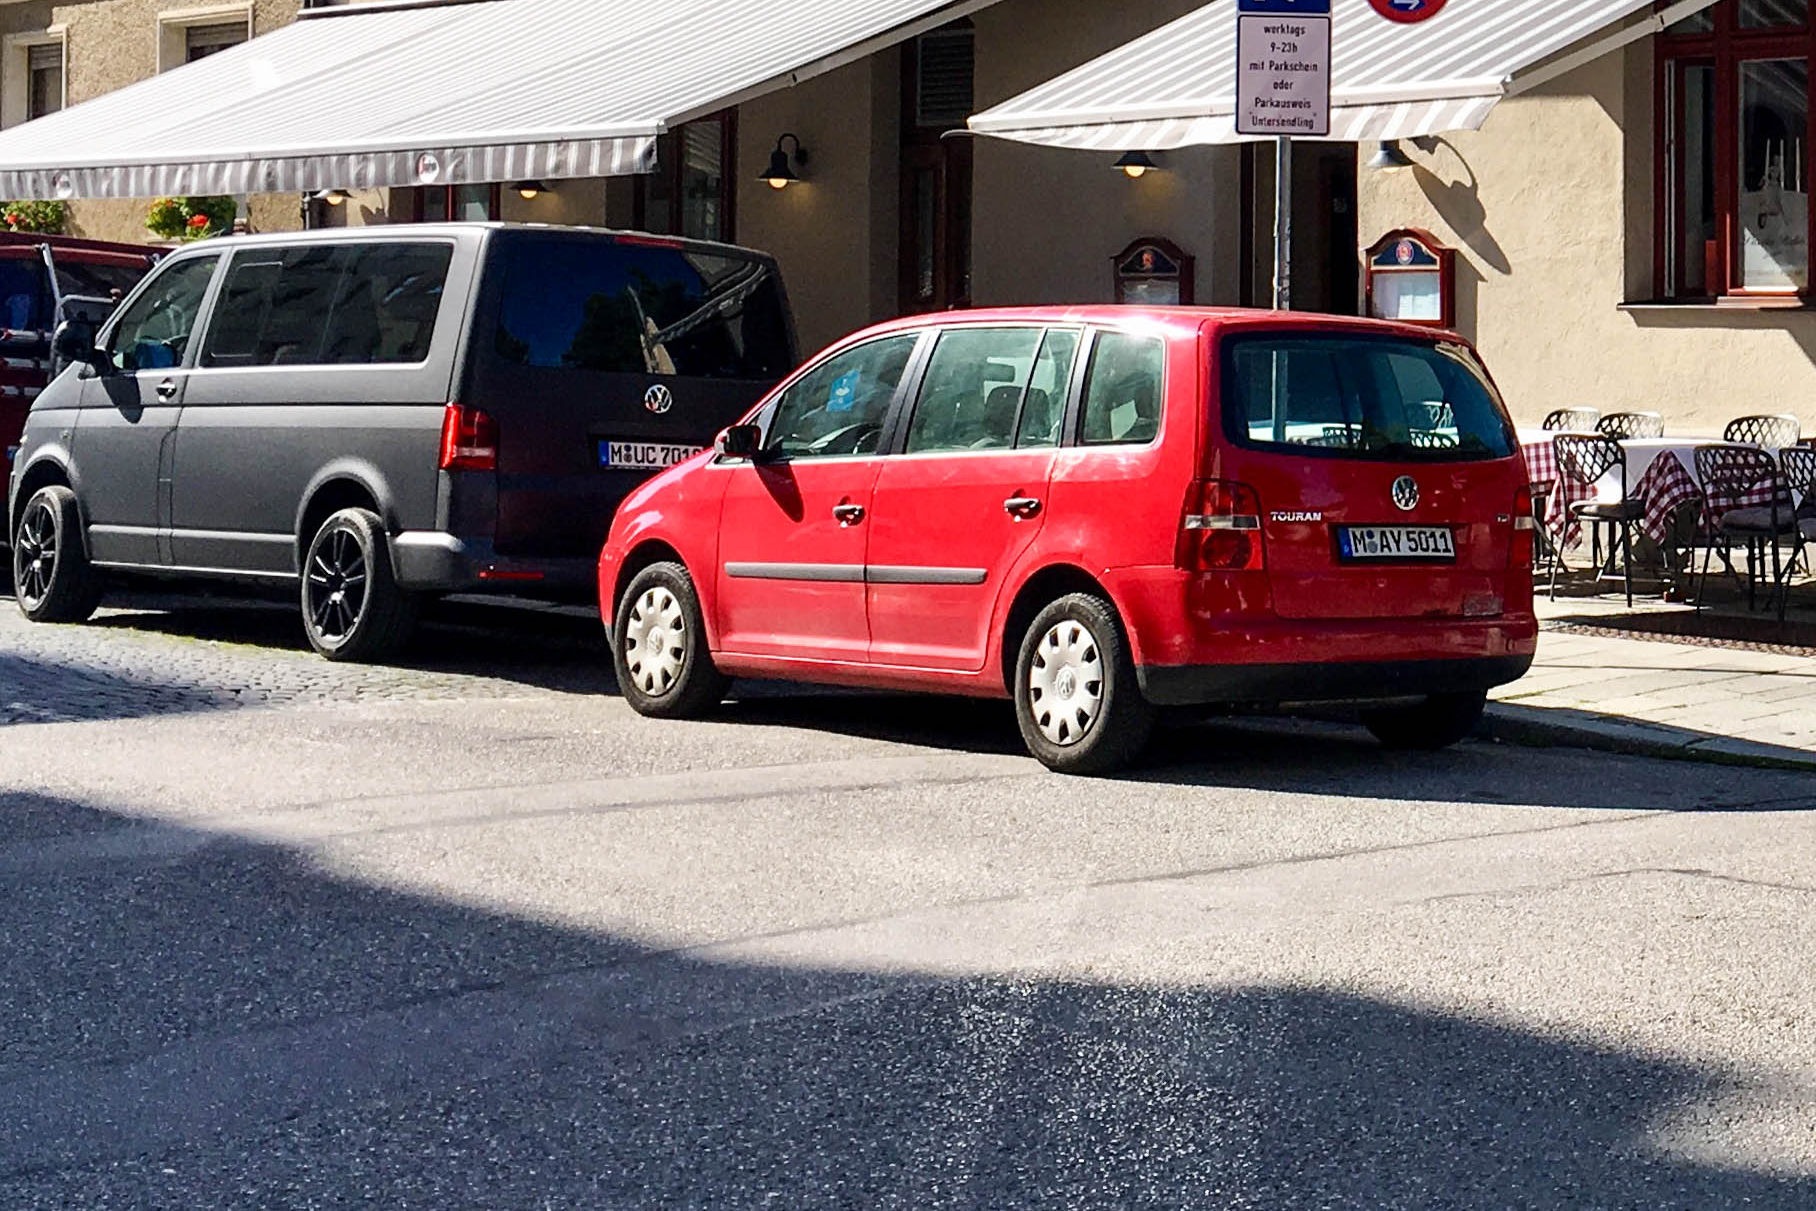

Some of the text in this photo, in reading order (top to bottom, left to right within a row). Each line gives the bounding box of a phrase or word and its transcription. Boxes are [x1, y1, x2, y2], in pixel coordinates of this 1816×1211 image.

[1263, 23, 1306, 37] werktags
[1270, 41, 1298, 53] 9-23h
[1249, 60, 1318, 72] mit Parkschein
[1273, 79, 1294, 90] oder
[1254, 96, 1312, 109] Parkausweis
[610, 444, 623, 464] M
[634, 446, 657, 465] UC
[1270, 511, 1322, 522] TOURAN
[1351, 530, 1453, 553] M AY 5011
